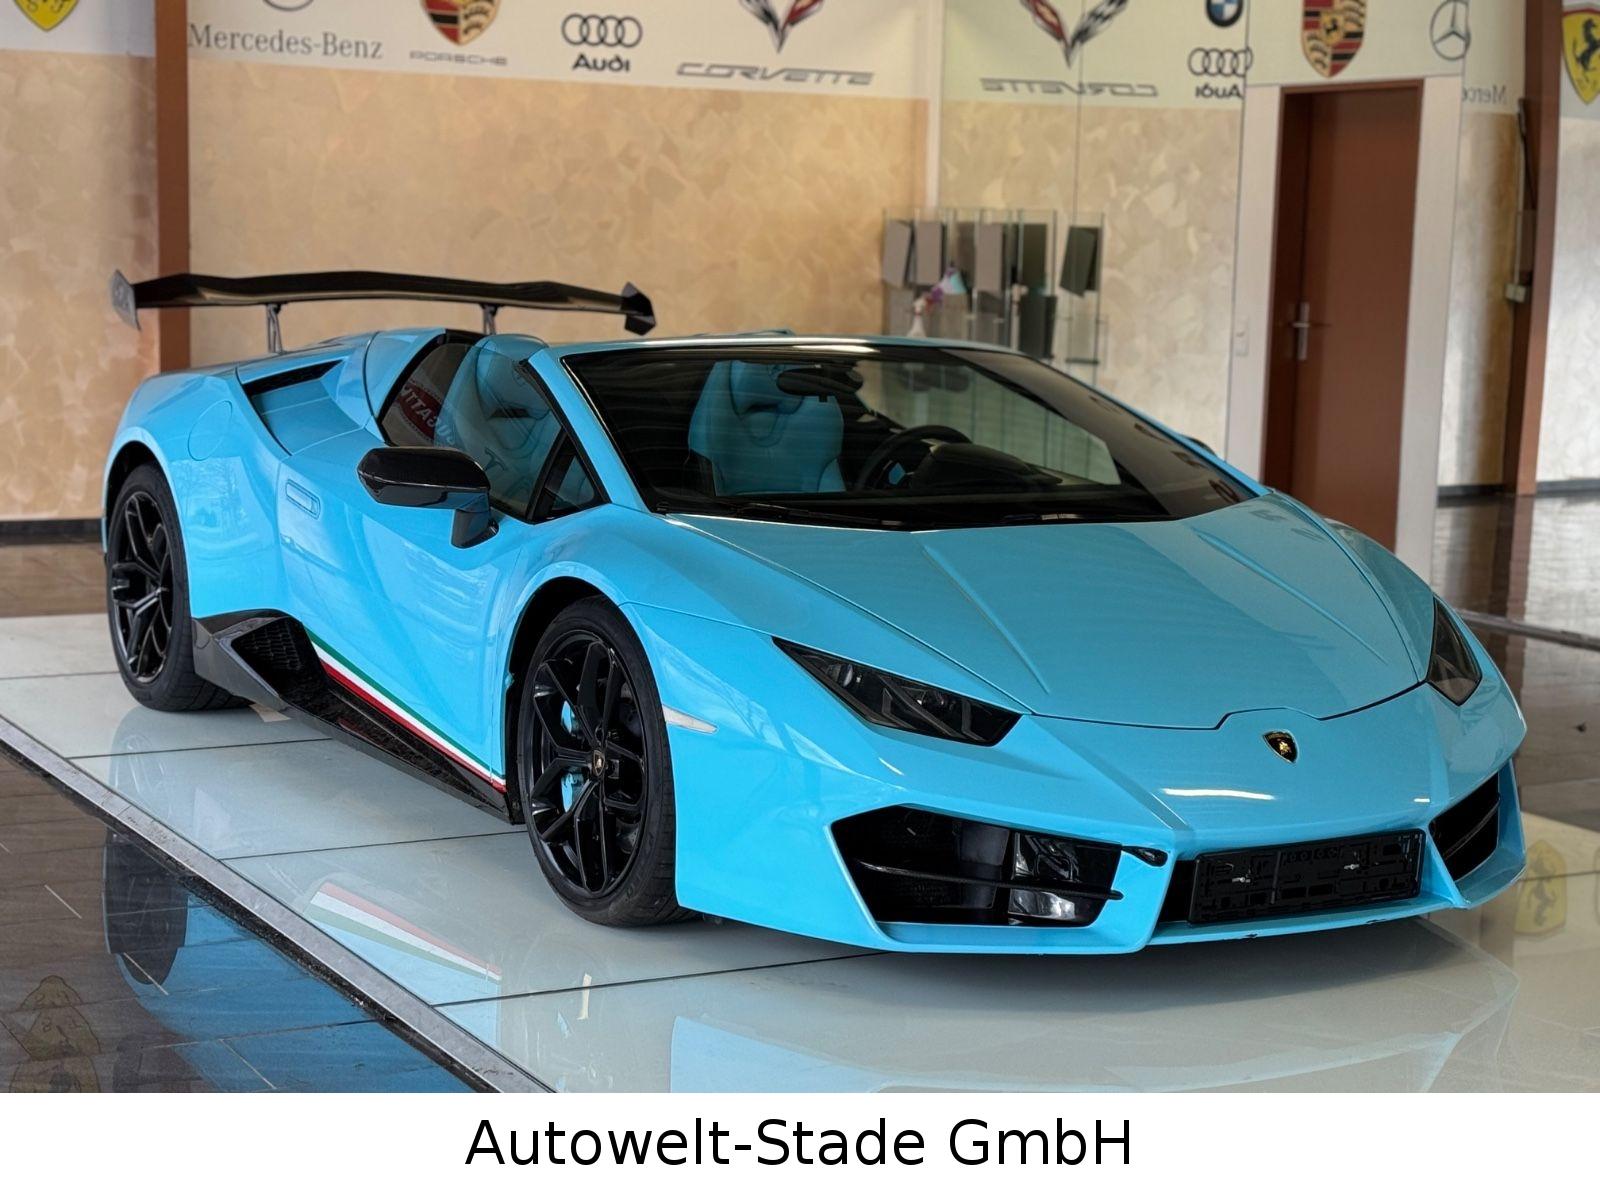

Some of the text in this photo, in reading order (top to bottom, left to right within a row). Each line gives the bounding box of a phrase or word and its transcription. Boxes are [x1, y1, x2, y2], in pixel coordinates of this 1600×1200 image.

[188, 23, 384, 59] Mercedes-Benz
[409, 50, 507, 66] PORSCHE
[571, 53, 631, 72] Audi
[676, 62, 874, 85] CORVETTE
